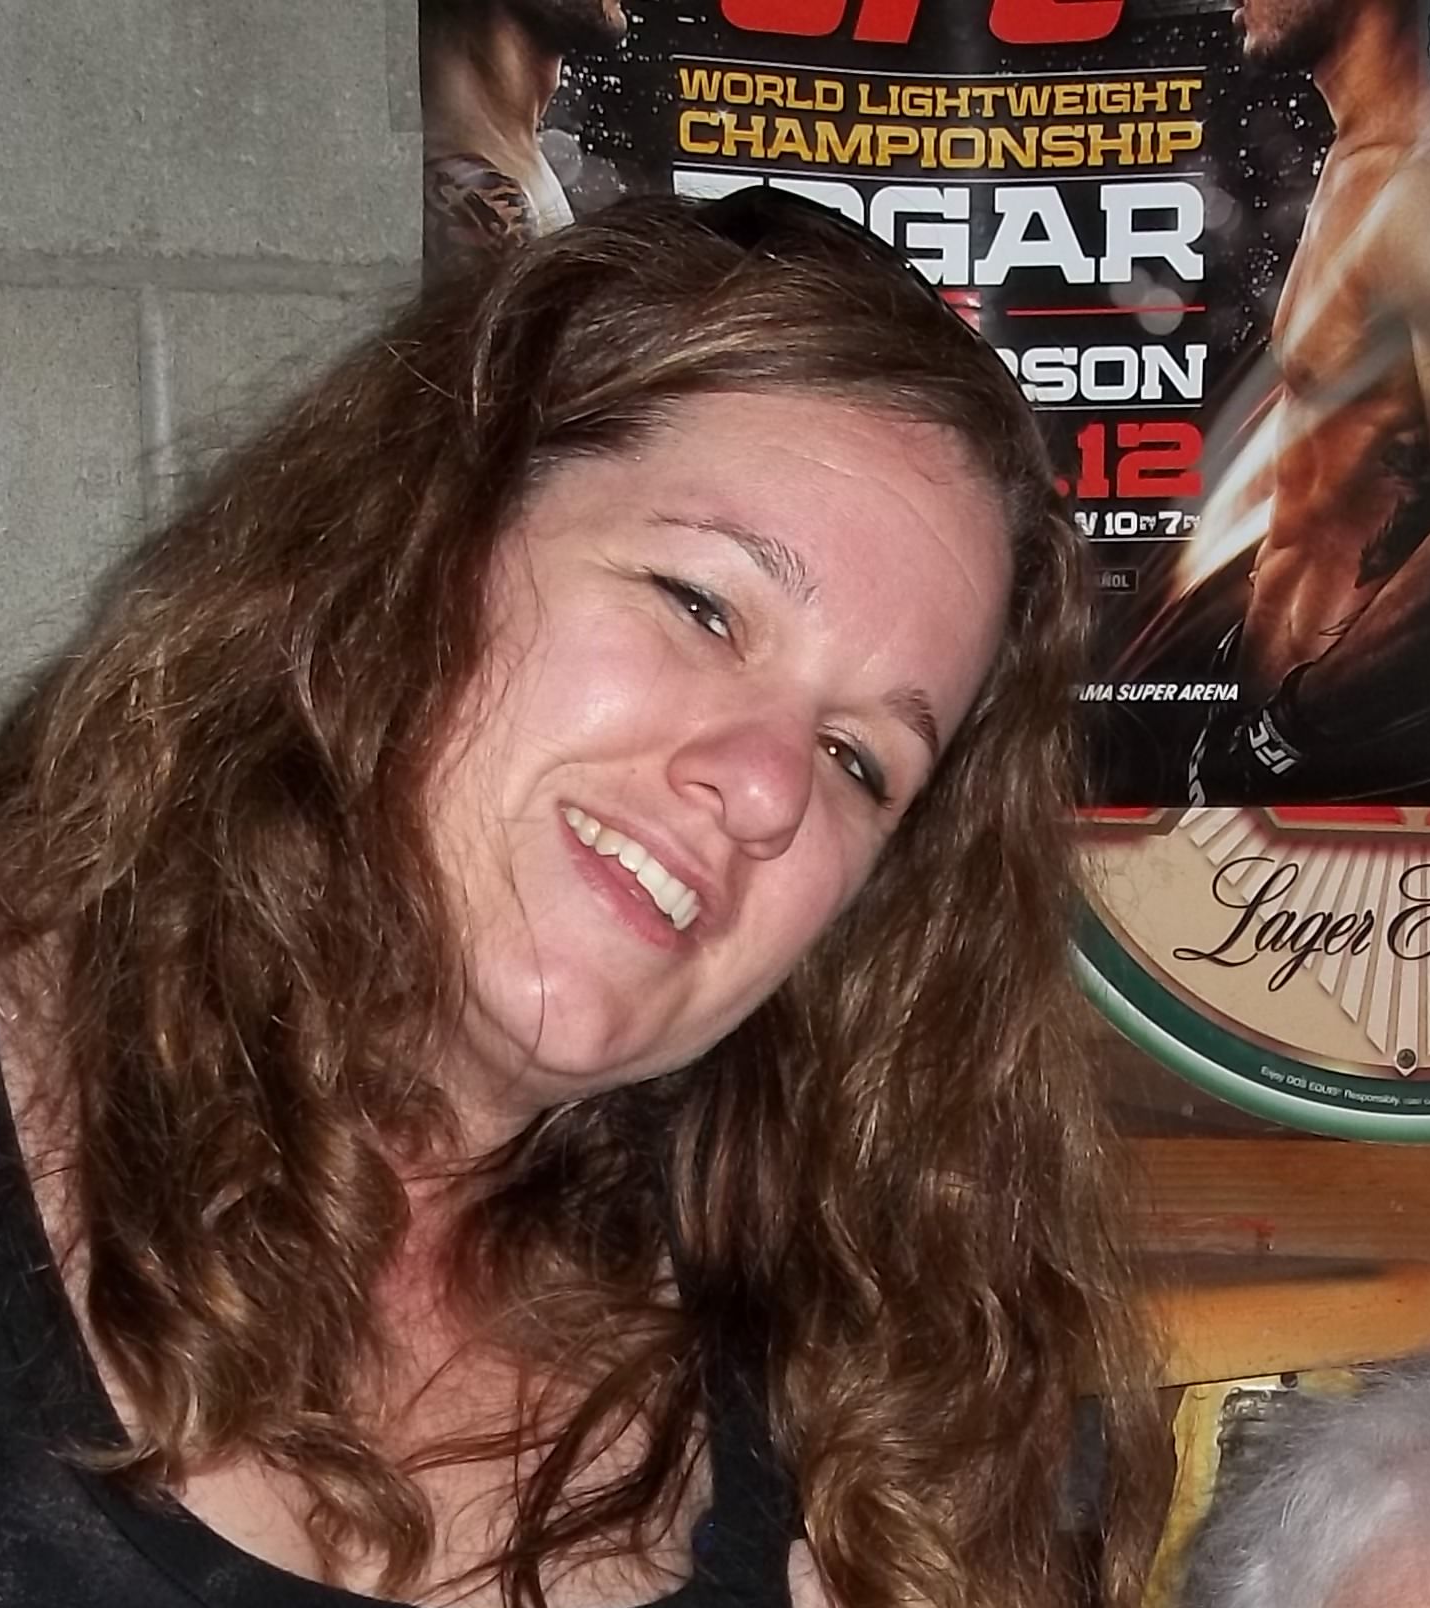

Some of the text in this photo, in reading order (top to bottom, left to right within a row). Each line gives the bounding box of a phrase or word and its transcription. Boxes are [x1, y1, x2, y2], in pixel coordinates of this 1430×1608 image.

[678, 67, 1203, 118] WORLD LIGHTWEIGHT
[678, 109, 1204, 170] CHAMPIONSHIP
[673, 170, 1205, 286] GAR
[1116, 683, 1178, 702] SUPER
[1176, 683, 1240, 702] ARENA
[1173, 857, 1375, 992] Lager
